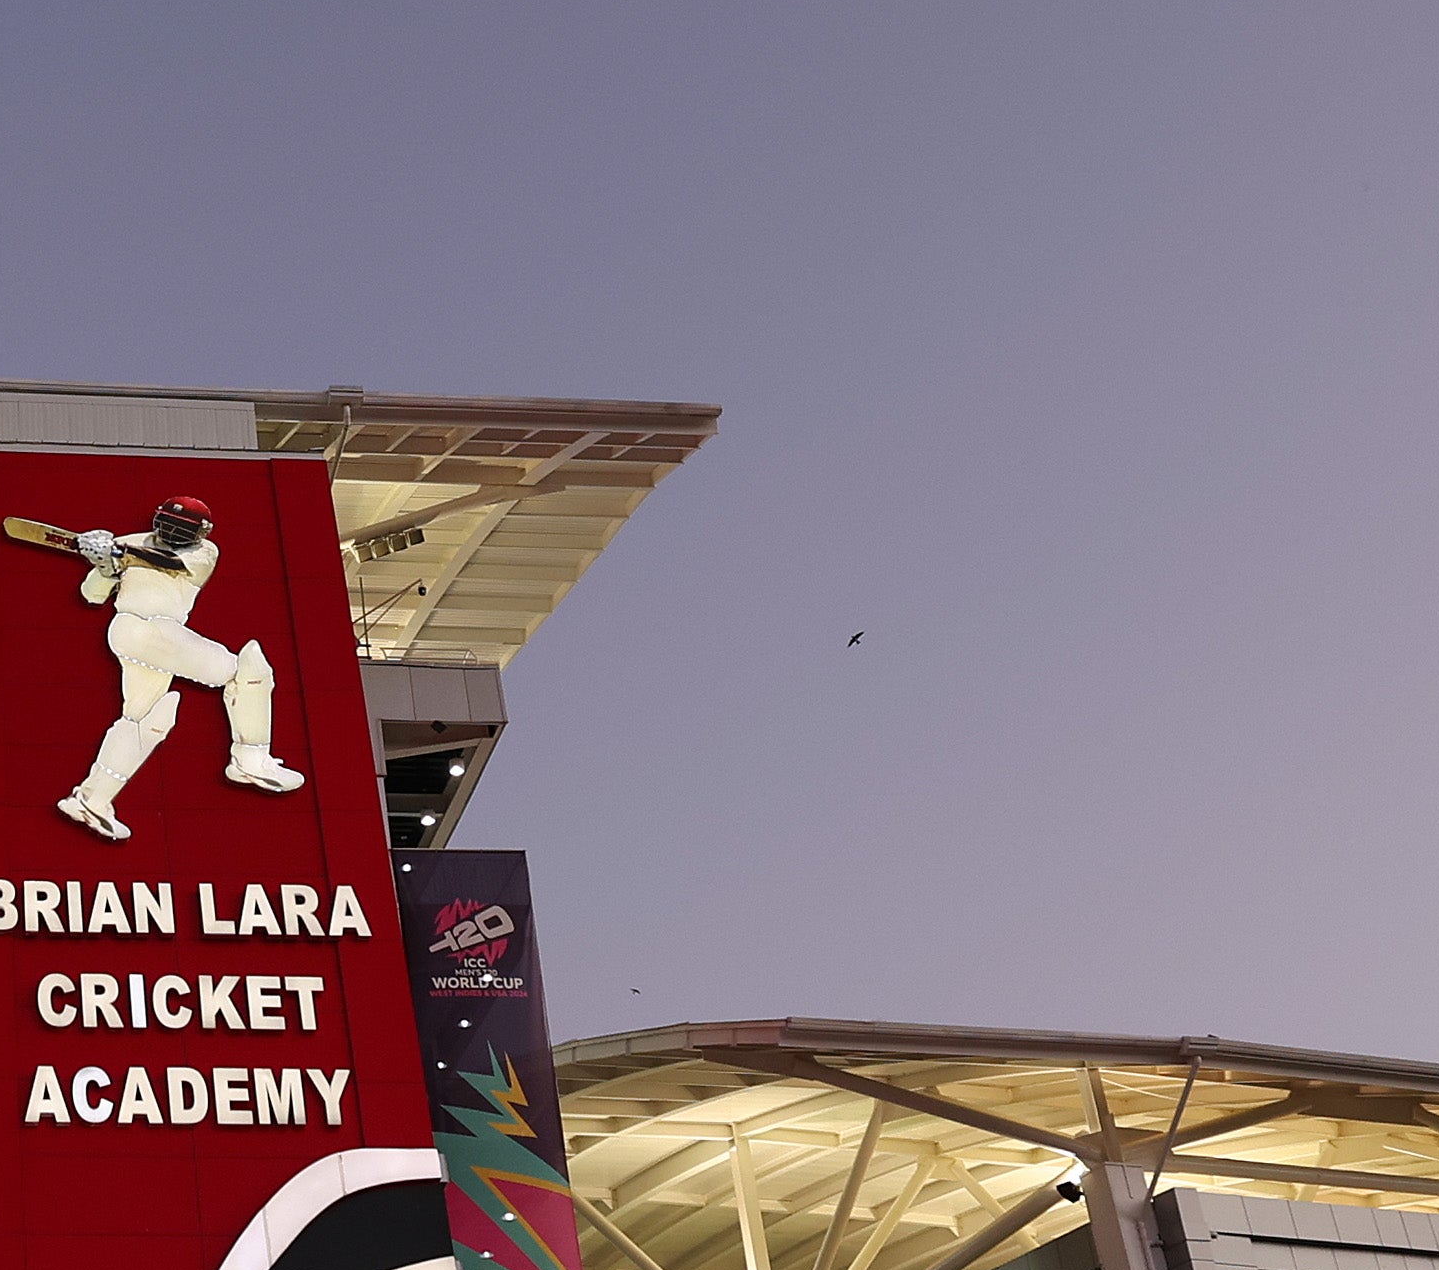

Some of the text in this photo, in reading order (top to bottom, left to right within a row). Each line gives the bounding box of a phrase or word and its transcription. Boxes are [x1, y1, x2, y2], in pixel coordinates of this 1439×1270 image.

[199, 882, 372, 937] LARA
[429, 905, 515, 953] T20
[431, 977, 524, 989] WORLD CUP
[464, 958, 486, 968] ICC
[37, 972, 325, 1031] CRICKET
[24, 1065, 351, 1125] ACADEMY
